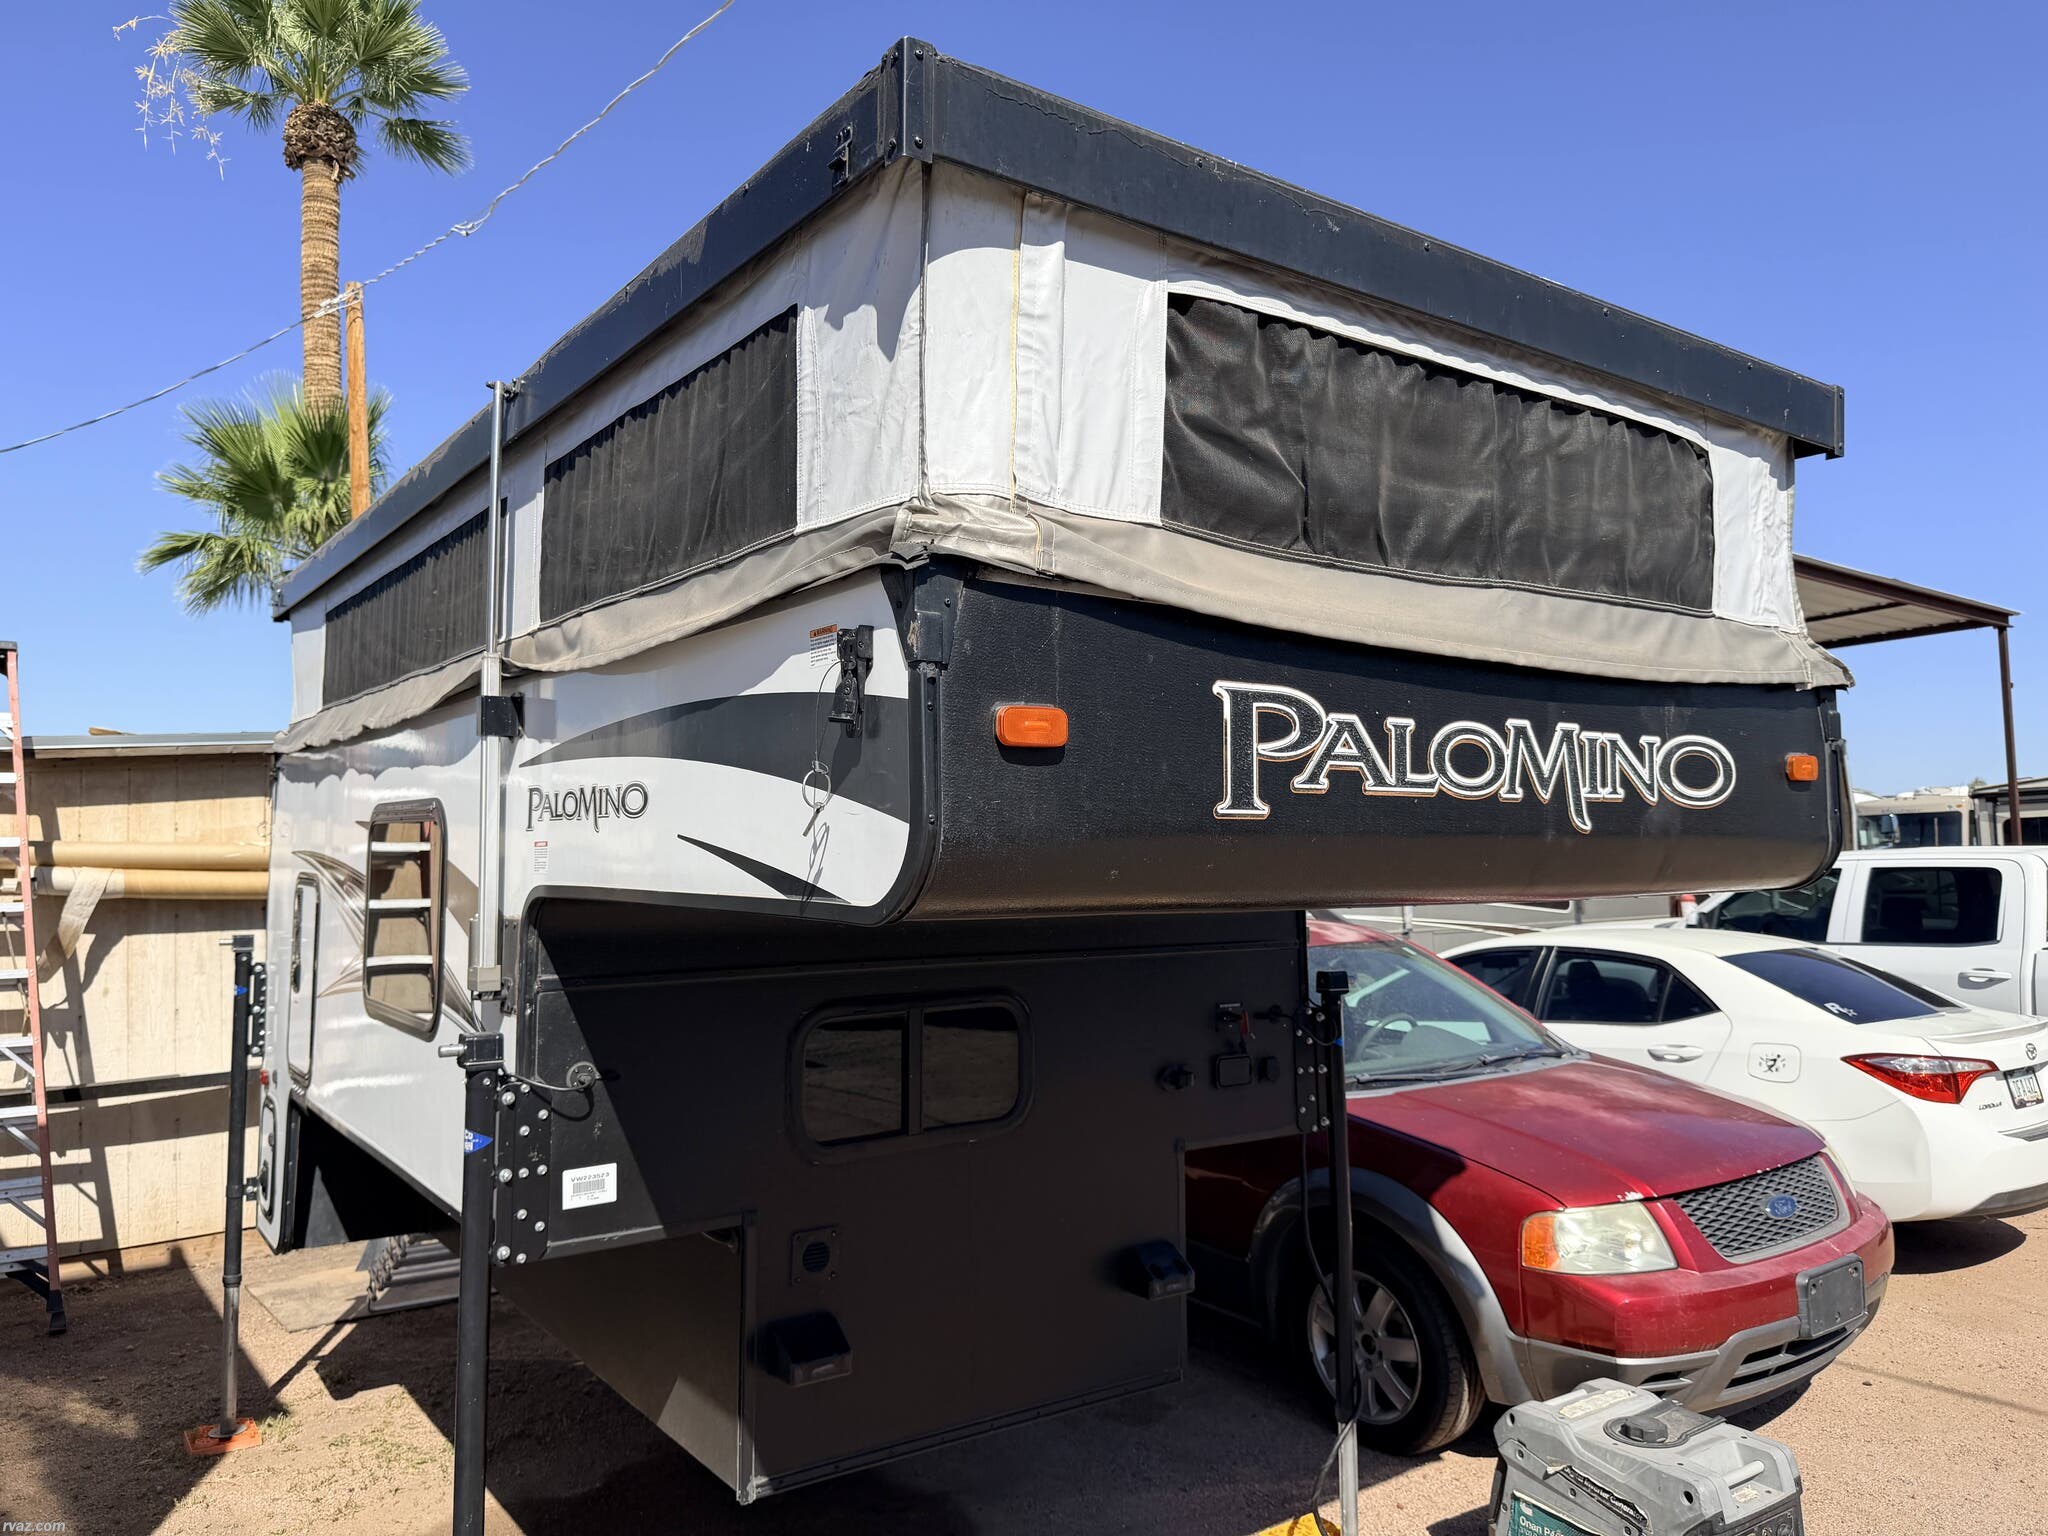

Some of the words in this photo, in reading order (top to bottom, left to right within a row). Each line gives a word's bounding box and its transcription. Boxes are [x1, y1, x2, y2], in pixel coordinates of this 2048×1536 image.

[1211, 679, 1738, 834] PALOMINO
[525, 780, 649, 834] PALOMINO
[1519, 1515, 1543, 1534] Onan
